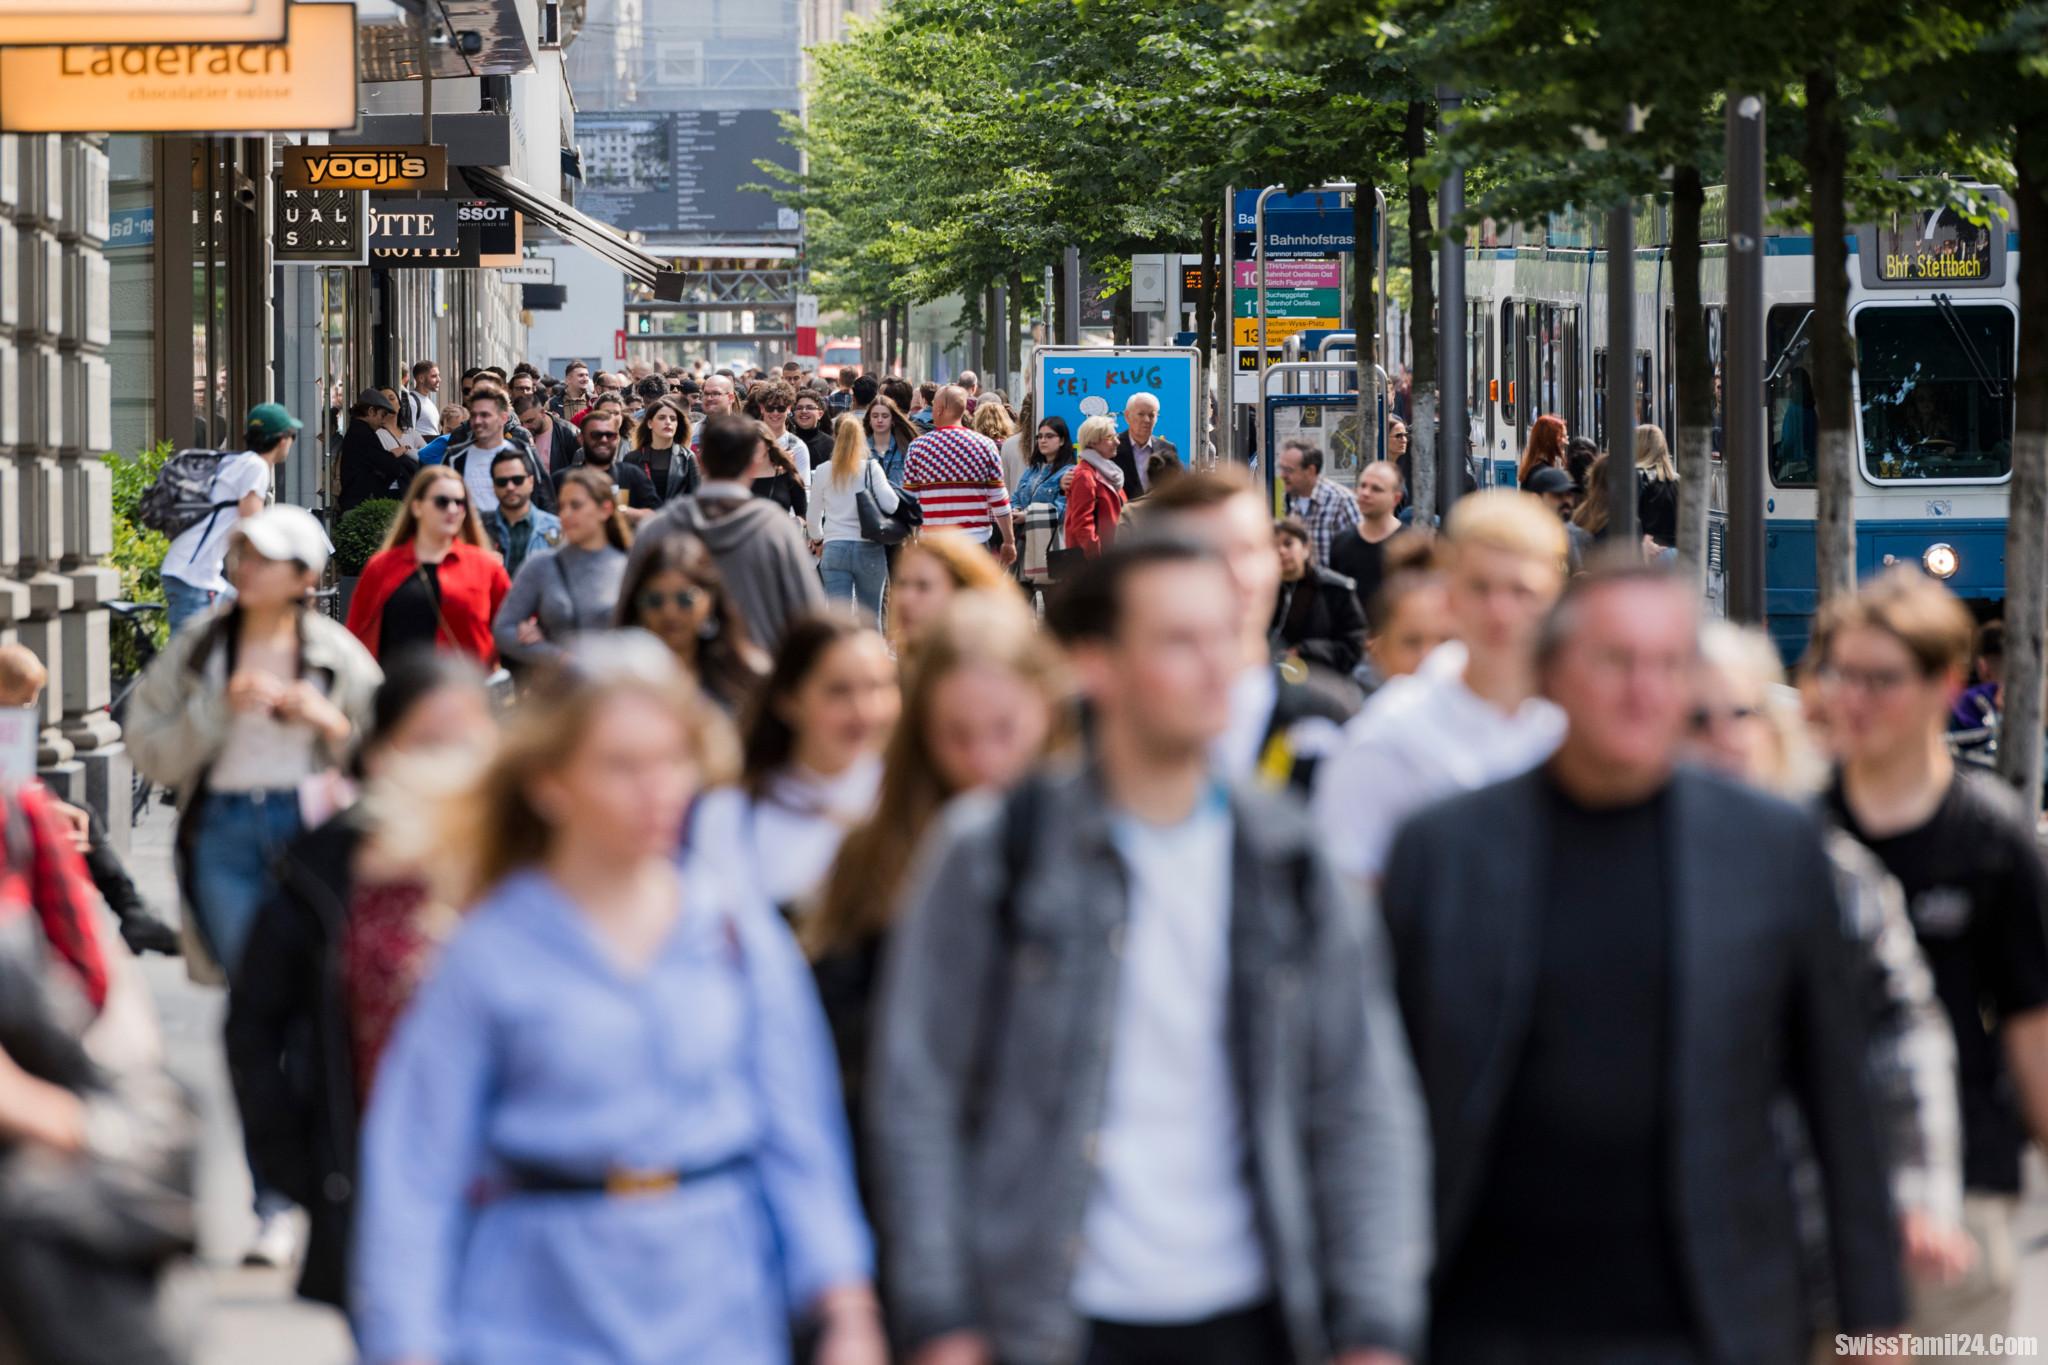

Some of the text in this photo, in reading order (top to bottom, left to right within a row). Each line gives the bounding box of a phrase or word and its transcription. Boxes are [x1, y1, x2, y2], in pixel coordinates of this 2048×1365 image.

[456, 207, 509, 221] SSOT
[503, 267, 551, 276] DIESEL
[1886, 254, 1981, 278] Bhf. Stettbach
[1243, 328, 1258, 343] 13
[1242, 357, 1255, 367] N1
[1105, 366, 1163, 390] KLUG
